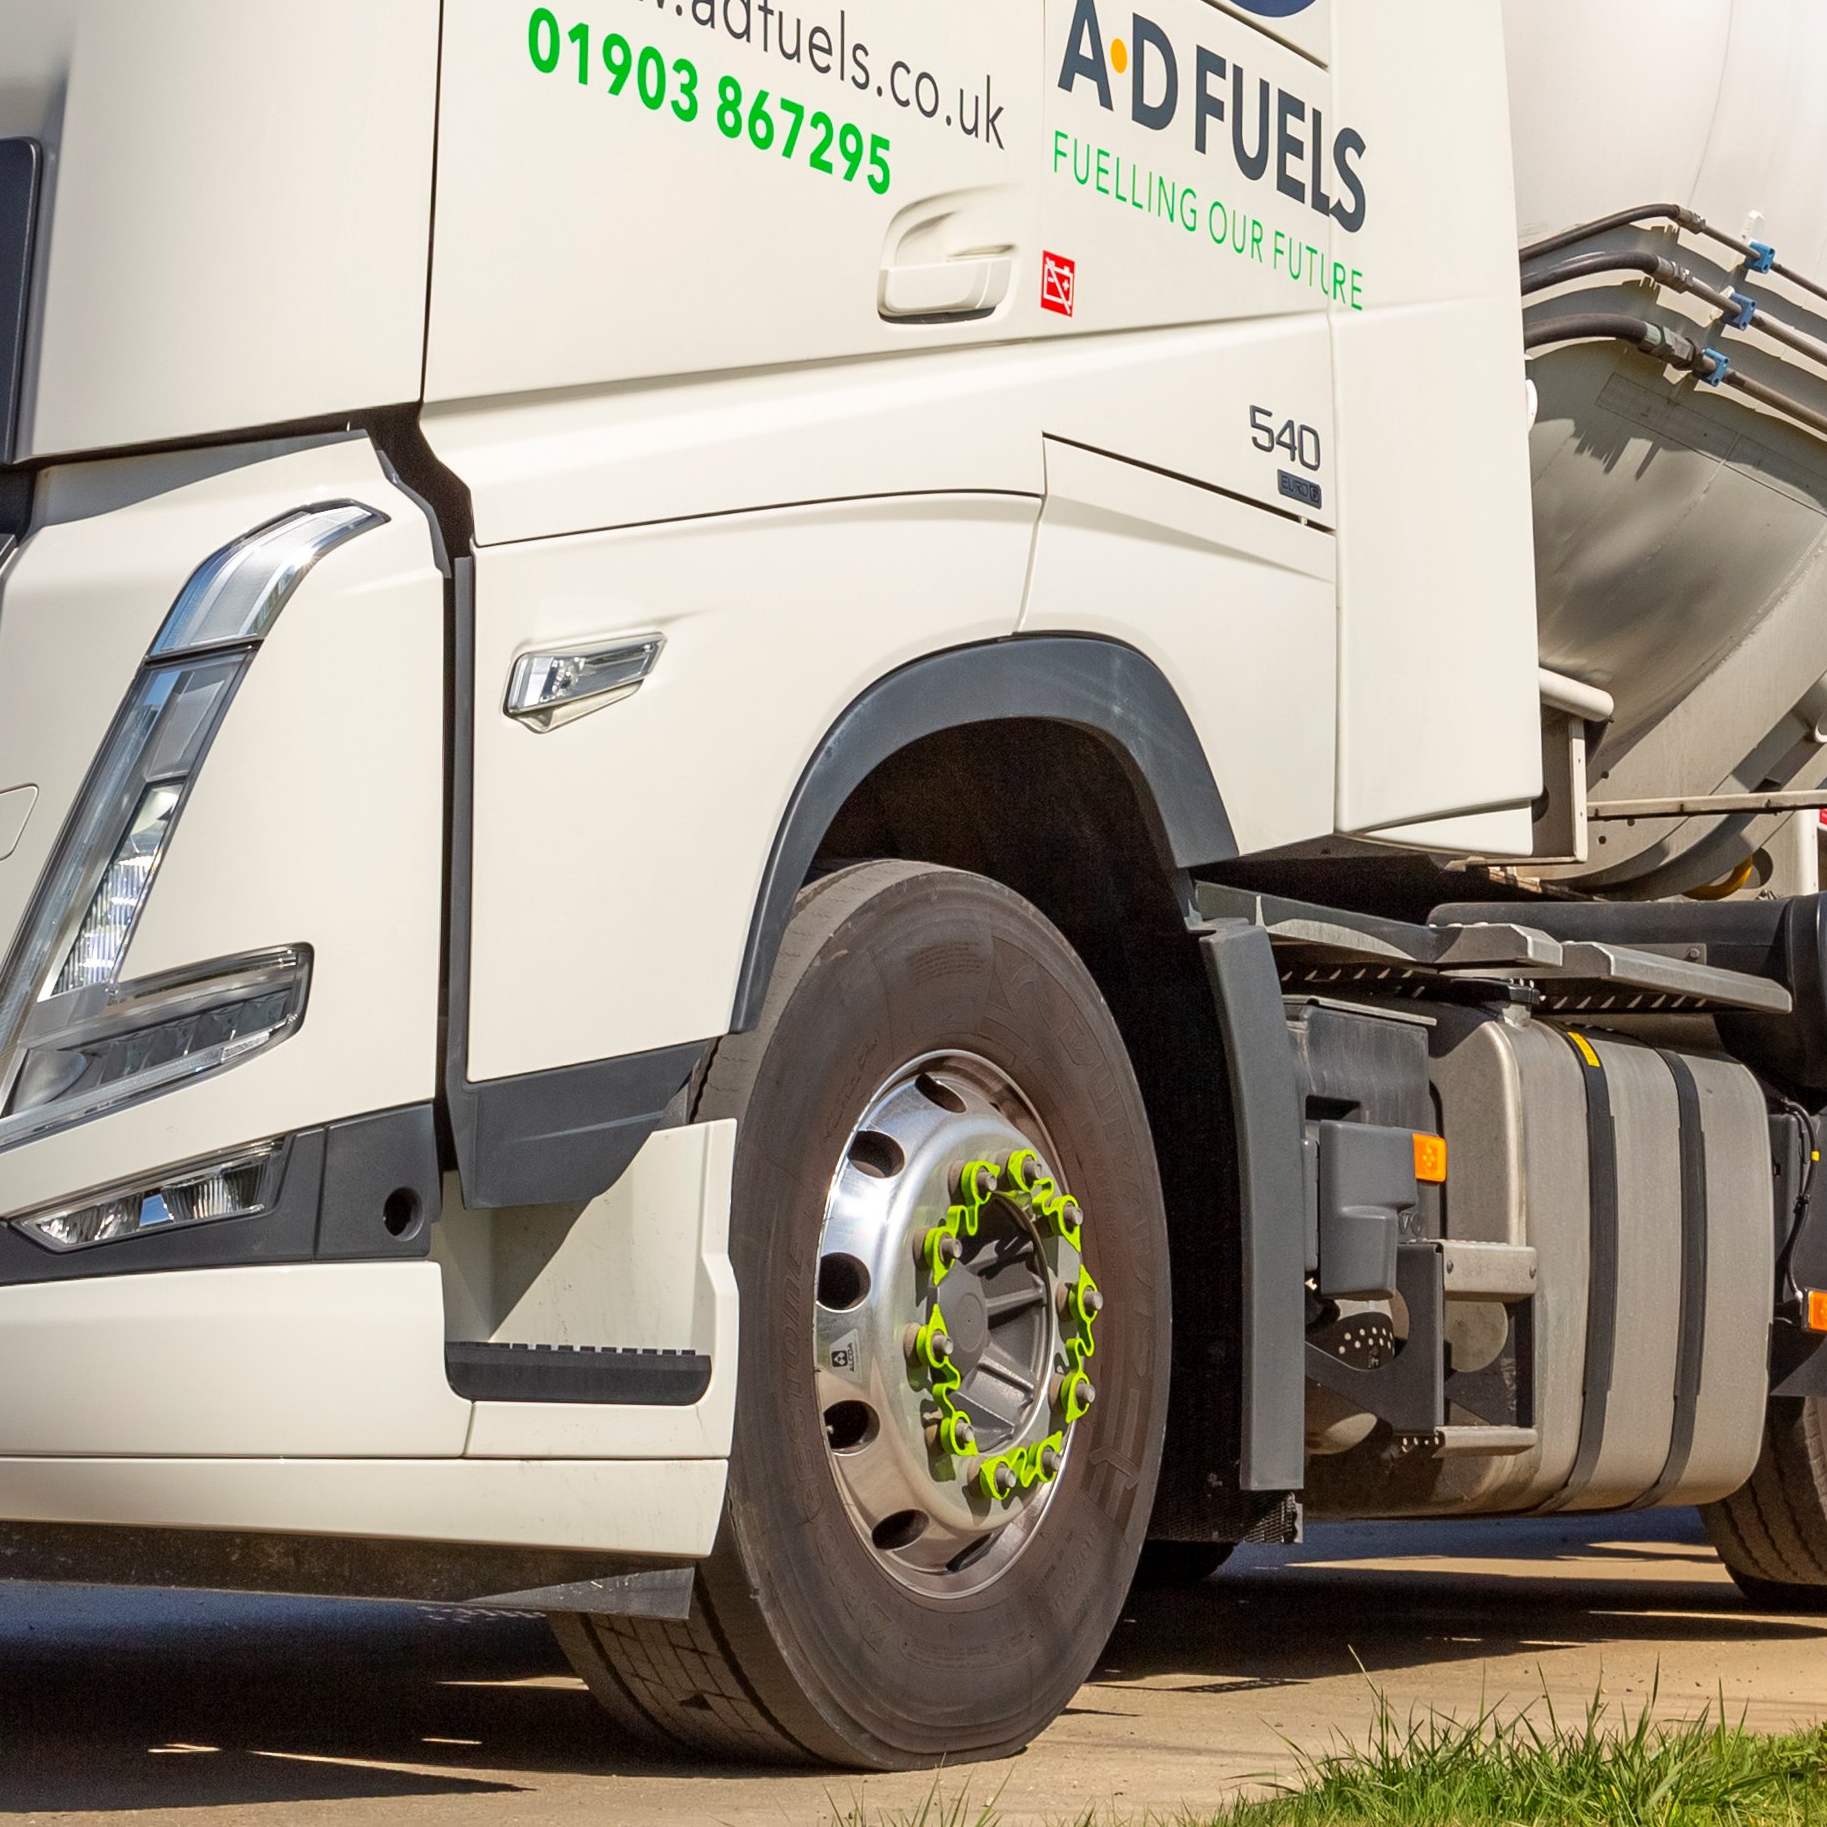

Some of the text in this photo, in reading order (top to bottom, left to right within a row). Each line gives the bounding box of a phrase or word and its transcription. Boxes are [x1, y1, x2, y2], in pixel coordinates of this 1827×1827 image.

[527, 6, 892, 196] 01903 867295
[1194, 44, 1367, 233] FUELS
[1053, 130, 1363, 311] FUELLING OUR FUTURE
[1249, 404, 1321, 471] 540
